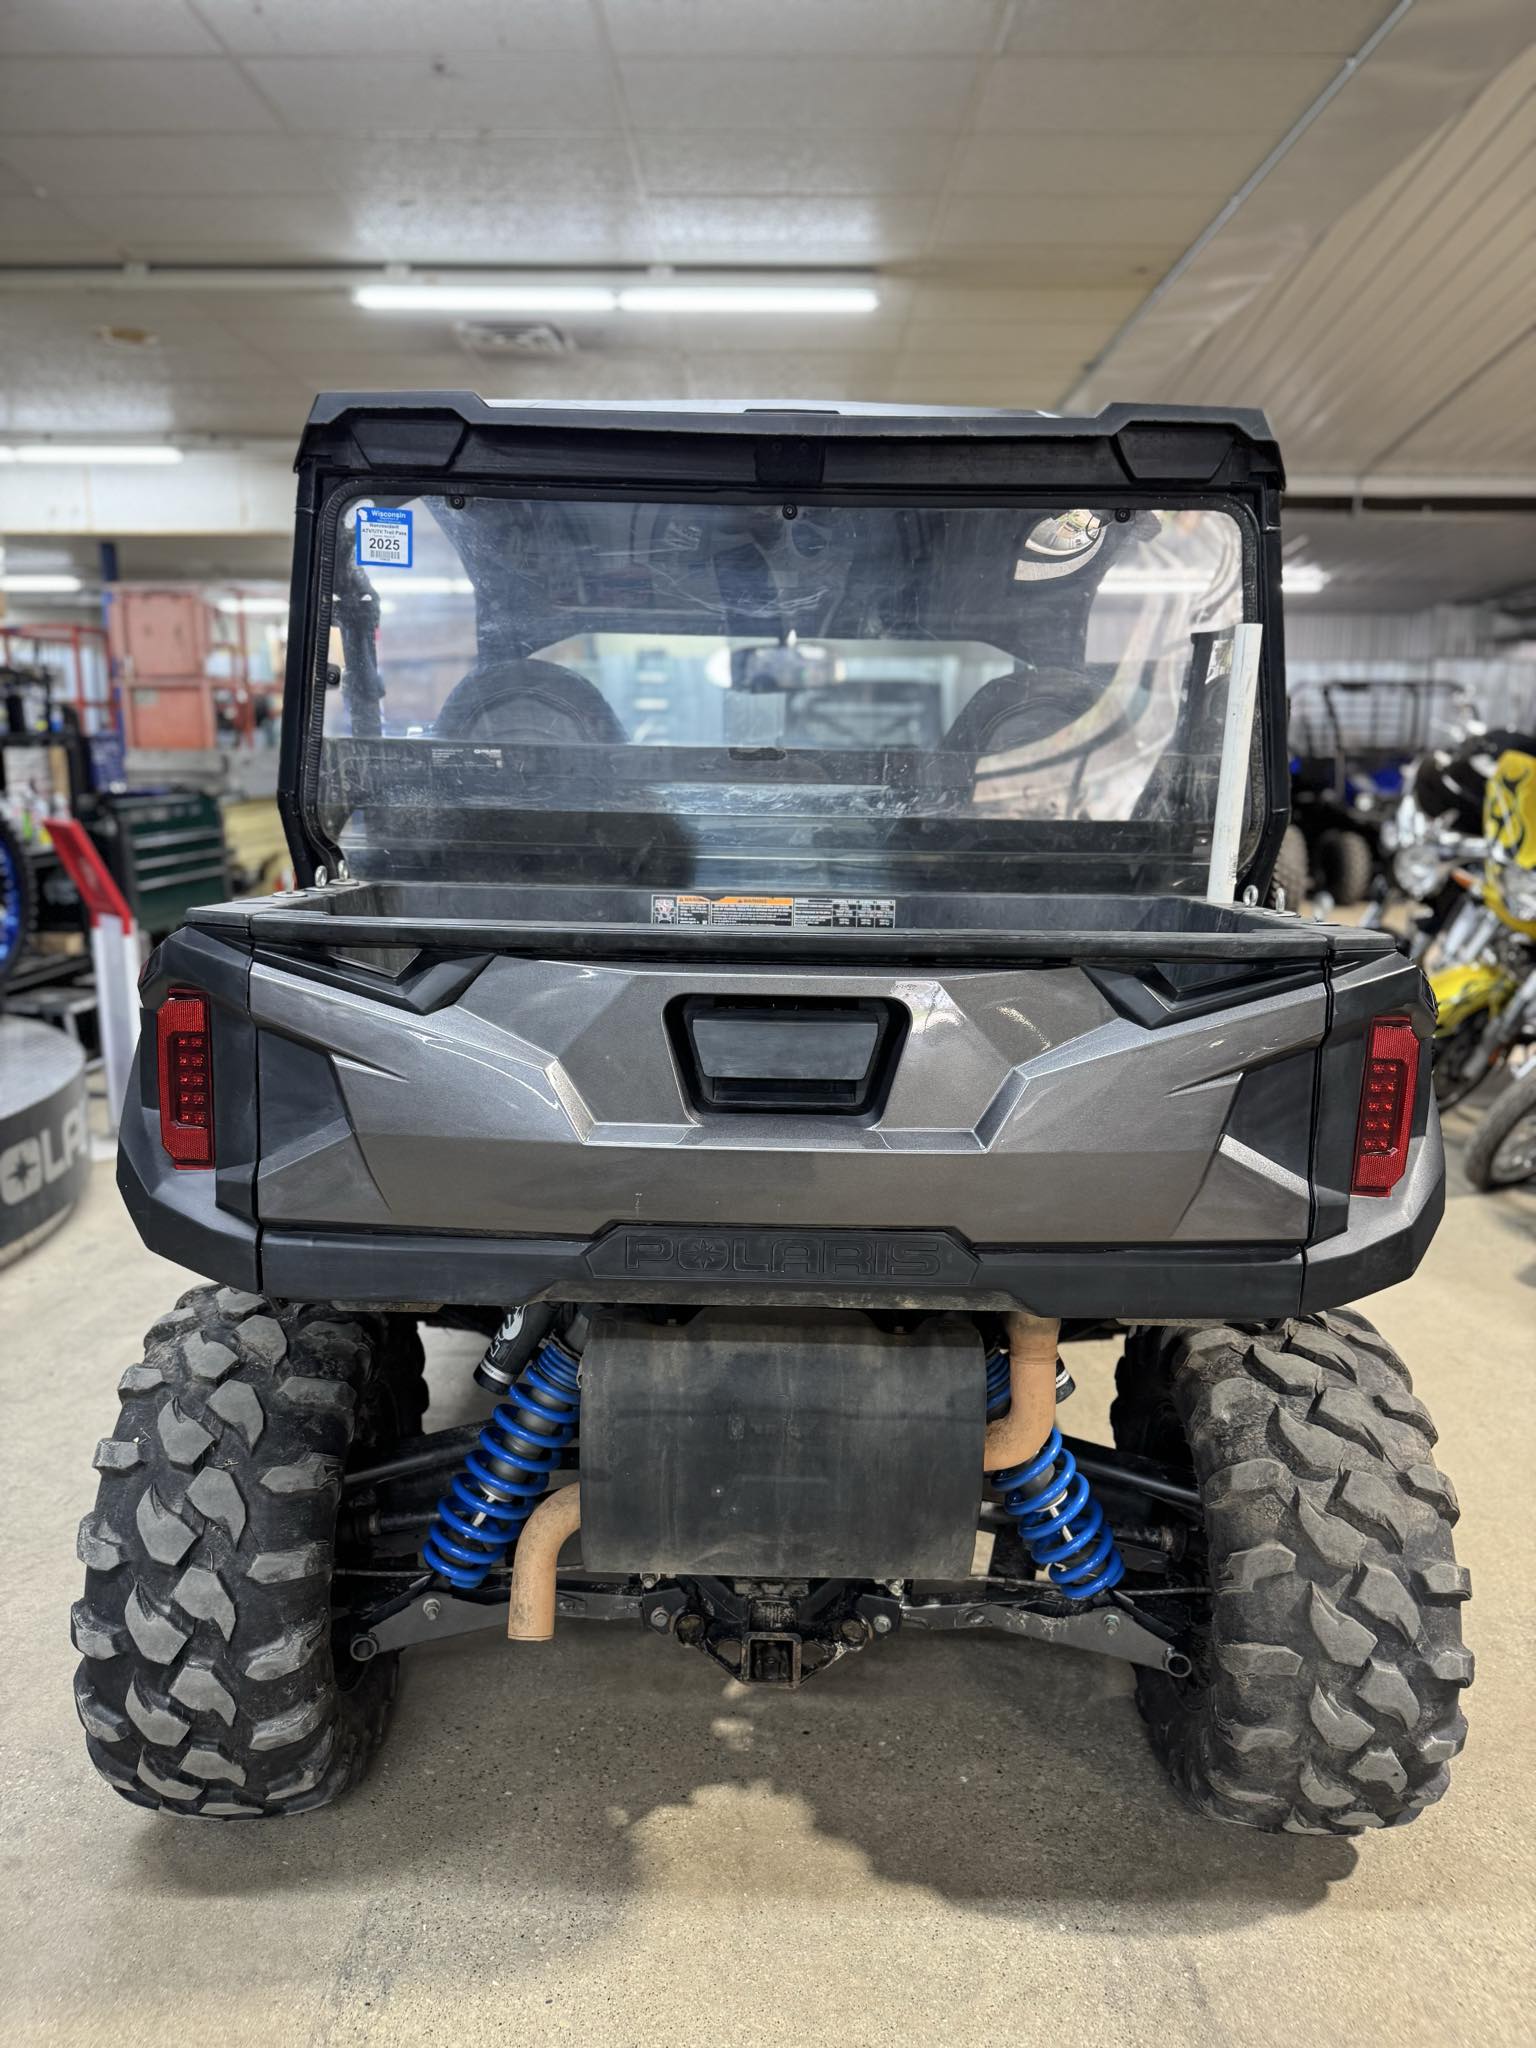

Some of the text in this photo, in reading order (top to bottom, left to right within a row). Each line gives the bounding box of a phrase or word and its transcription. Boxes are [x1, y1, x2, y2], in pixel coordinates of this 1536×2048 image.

[371, 509, 406, 519] Wisconsin
[369, 537, 400, 551] 2025
[625, 1235, 942, 1276] POLARIS
